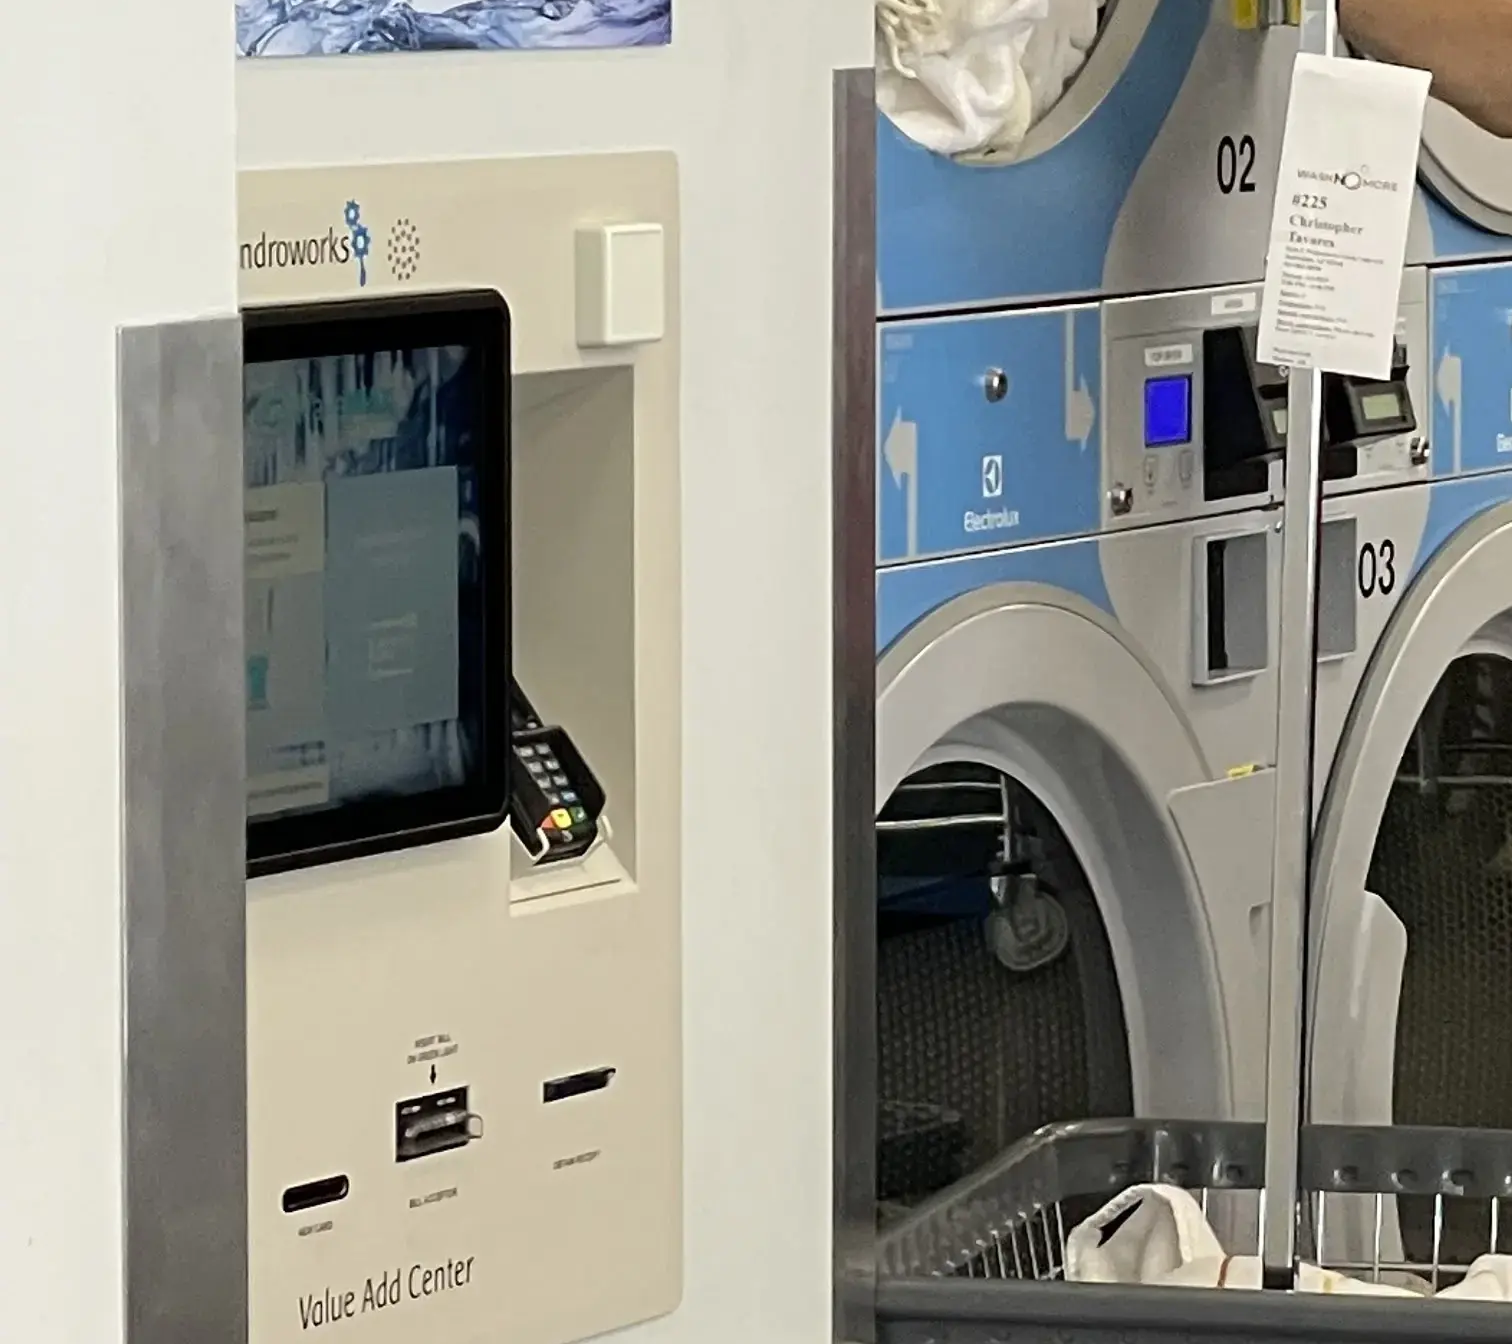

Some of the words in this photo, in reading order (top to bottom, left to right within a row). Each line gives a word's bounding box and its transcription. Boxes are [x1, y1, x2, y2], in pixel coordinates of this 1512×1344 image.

[1215, 134, 1257, 194] 02
[1292, 193, 1329, 210] #225
[964, 507, 1020, 532] Electrolux
[1358, 538, 1396, 599] 03
[298, 1286, 355, 1330] Value
[361, 1267, 401, 1314] Add
[408, 1256, 475, 1300] Center
